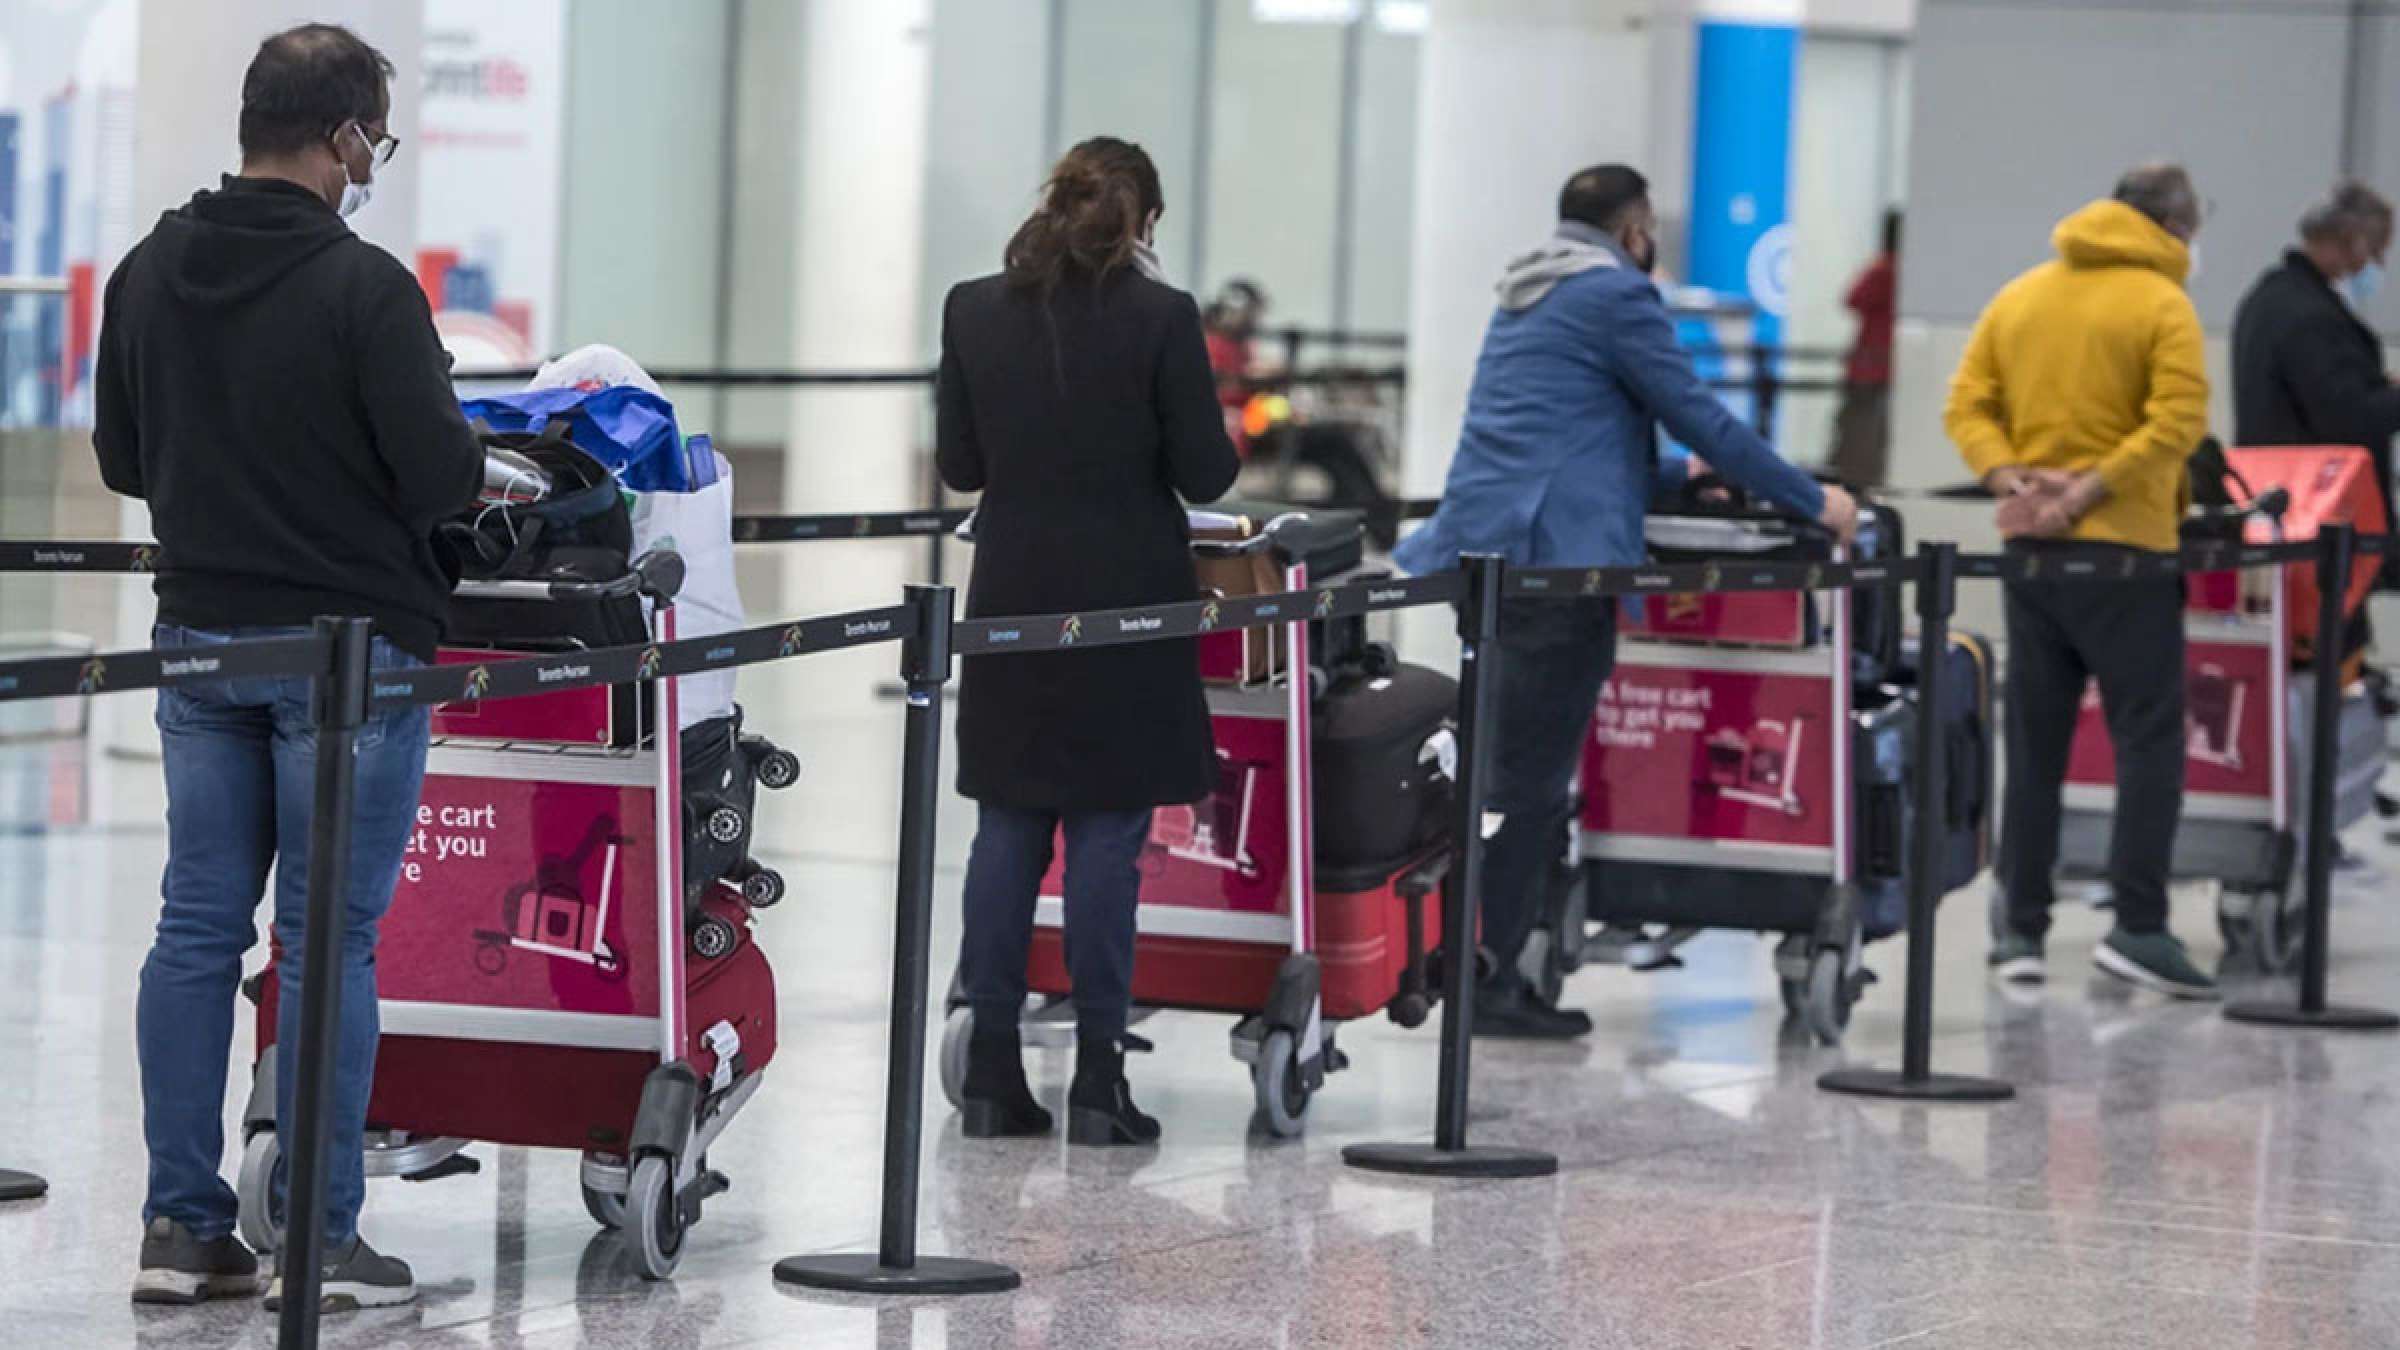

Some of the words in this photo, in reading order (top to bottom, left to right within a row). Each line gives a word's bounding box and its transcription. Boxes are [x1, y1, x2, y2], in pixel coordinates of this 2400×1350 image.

[1665, 687, 1712, 710] cart
[1663, 711, 1704, 733] you
[440, 803, 497, 829] cart
[434, 835, 487, 861] you
